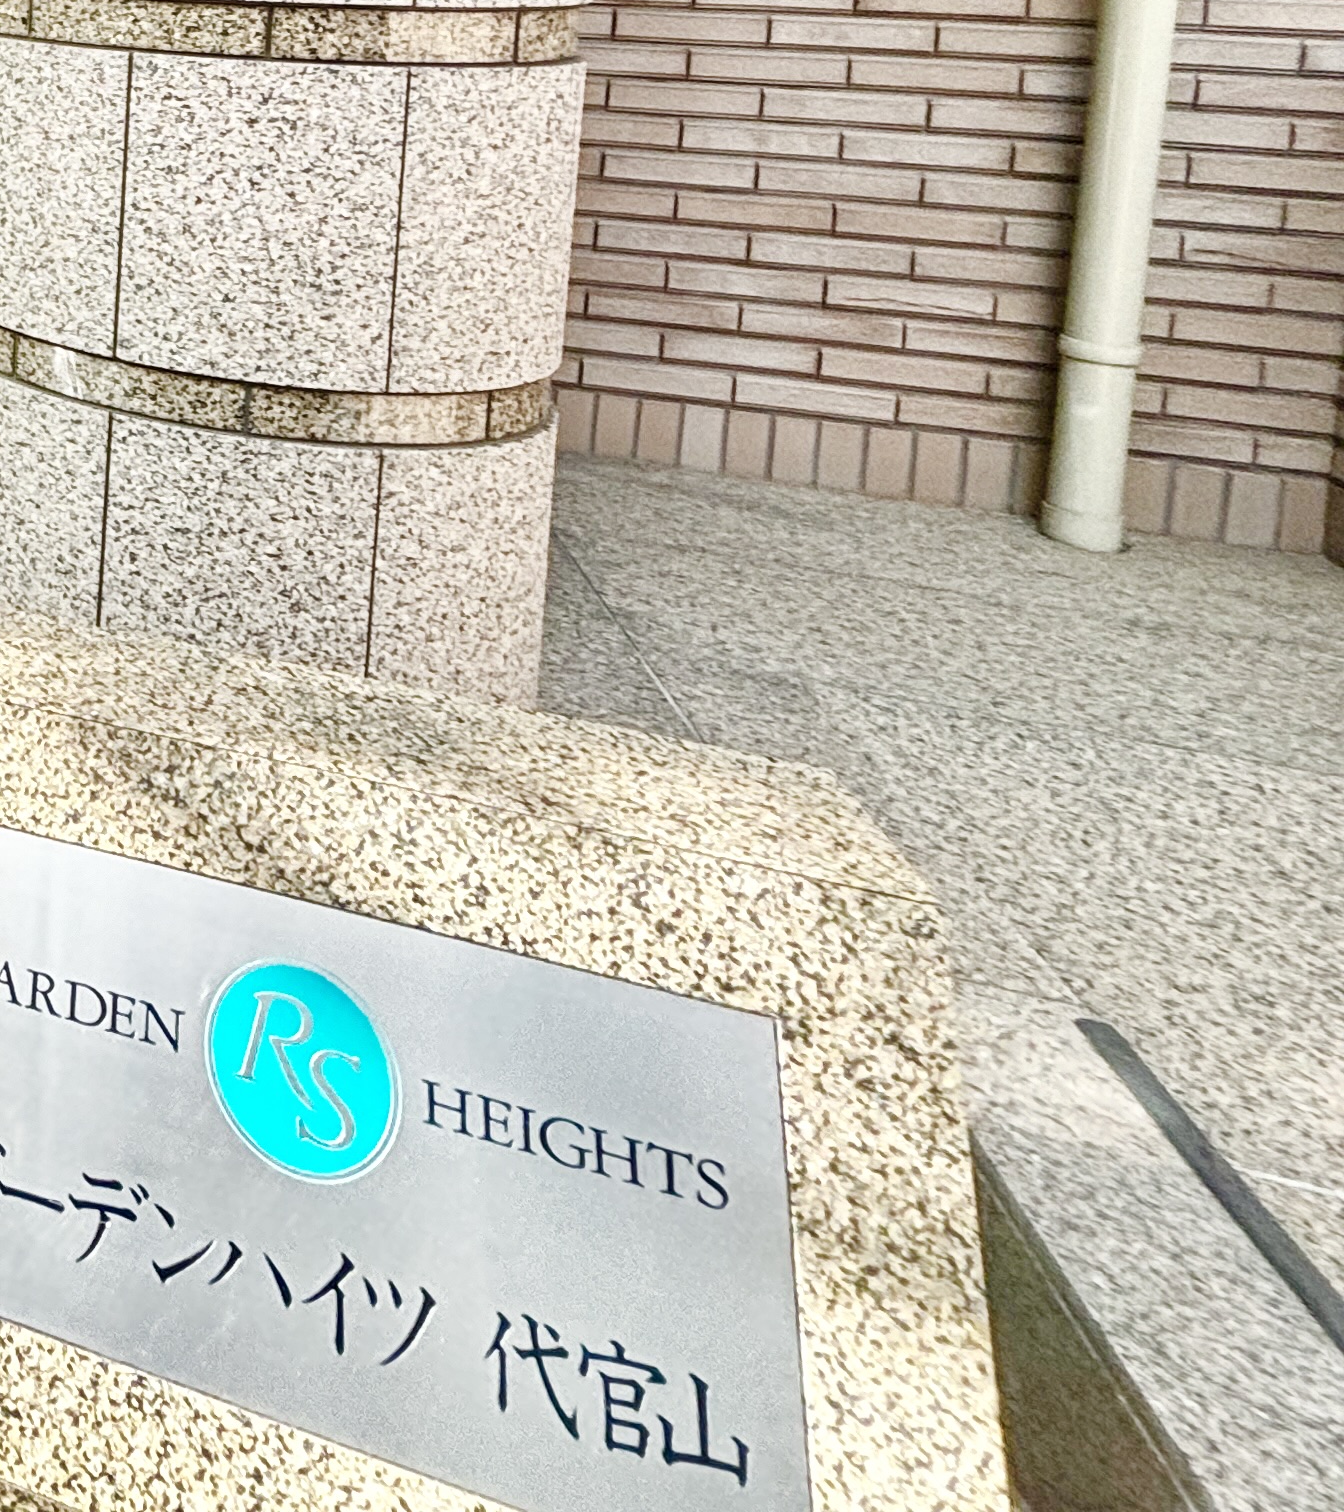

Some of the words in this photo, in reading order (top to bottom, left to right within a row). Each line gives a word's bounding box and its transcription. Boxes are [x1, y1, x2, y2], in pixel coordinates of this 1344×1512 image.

[423, 1080, 731, 1210] HEIGHTS
[484, 1310, 749, 1487] 代官山
